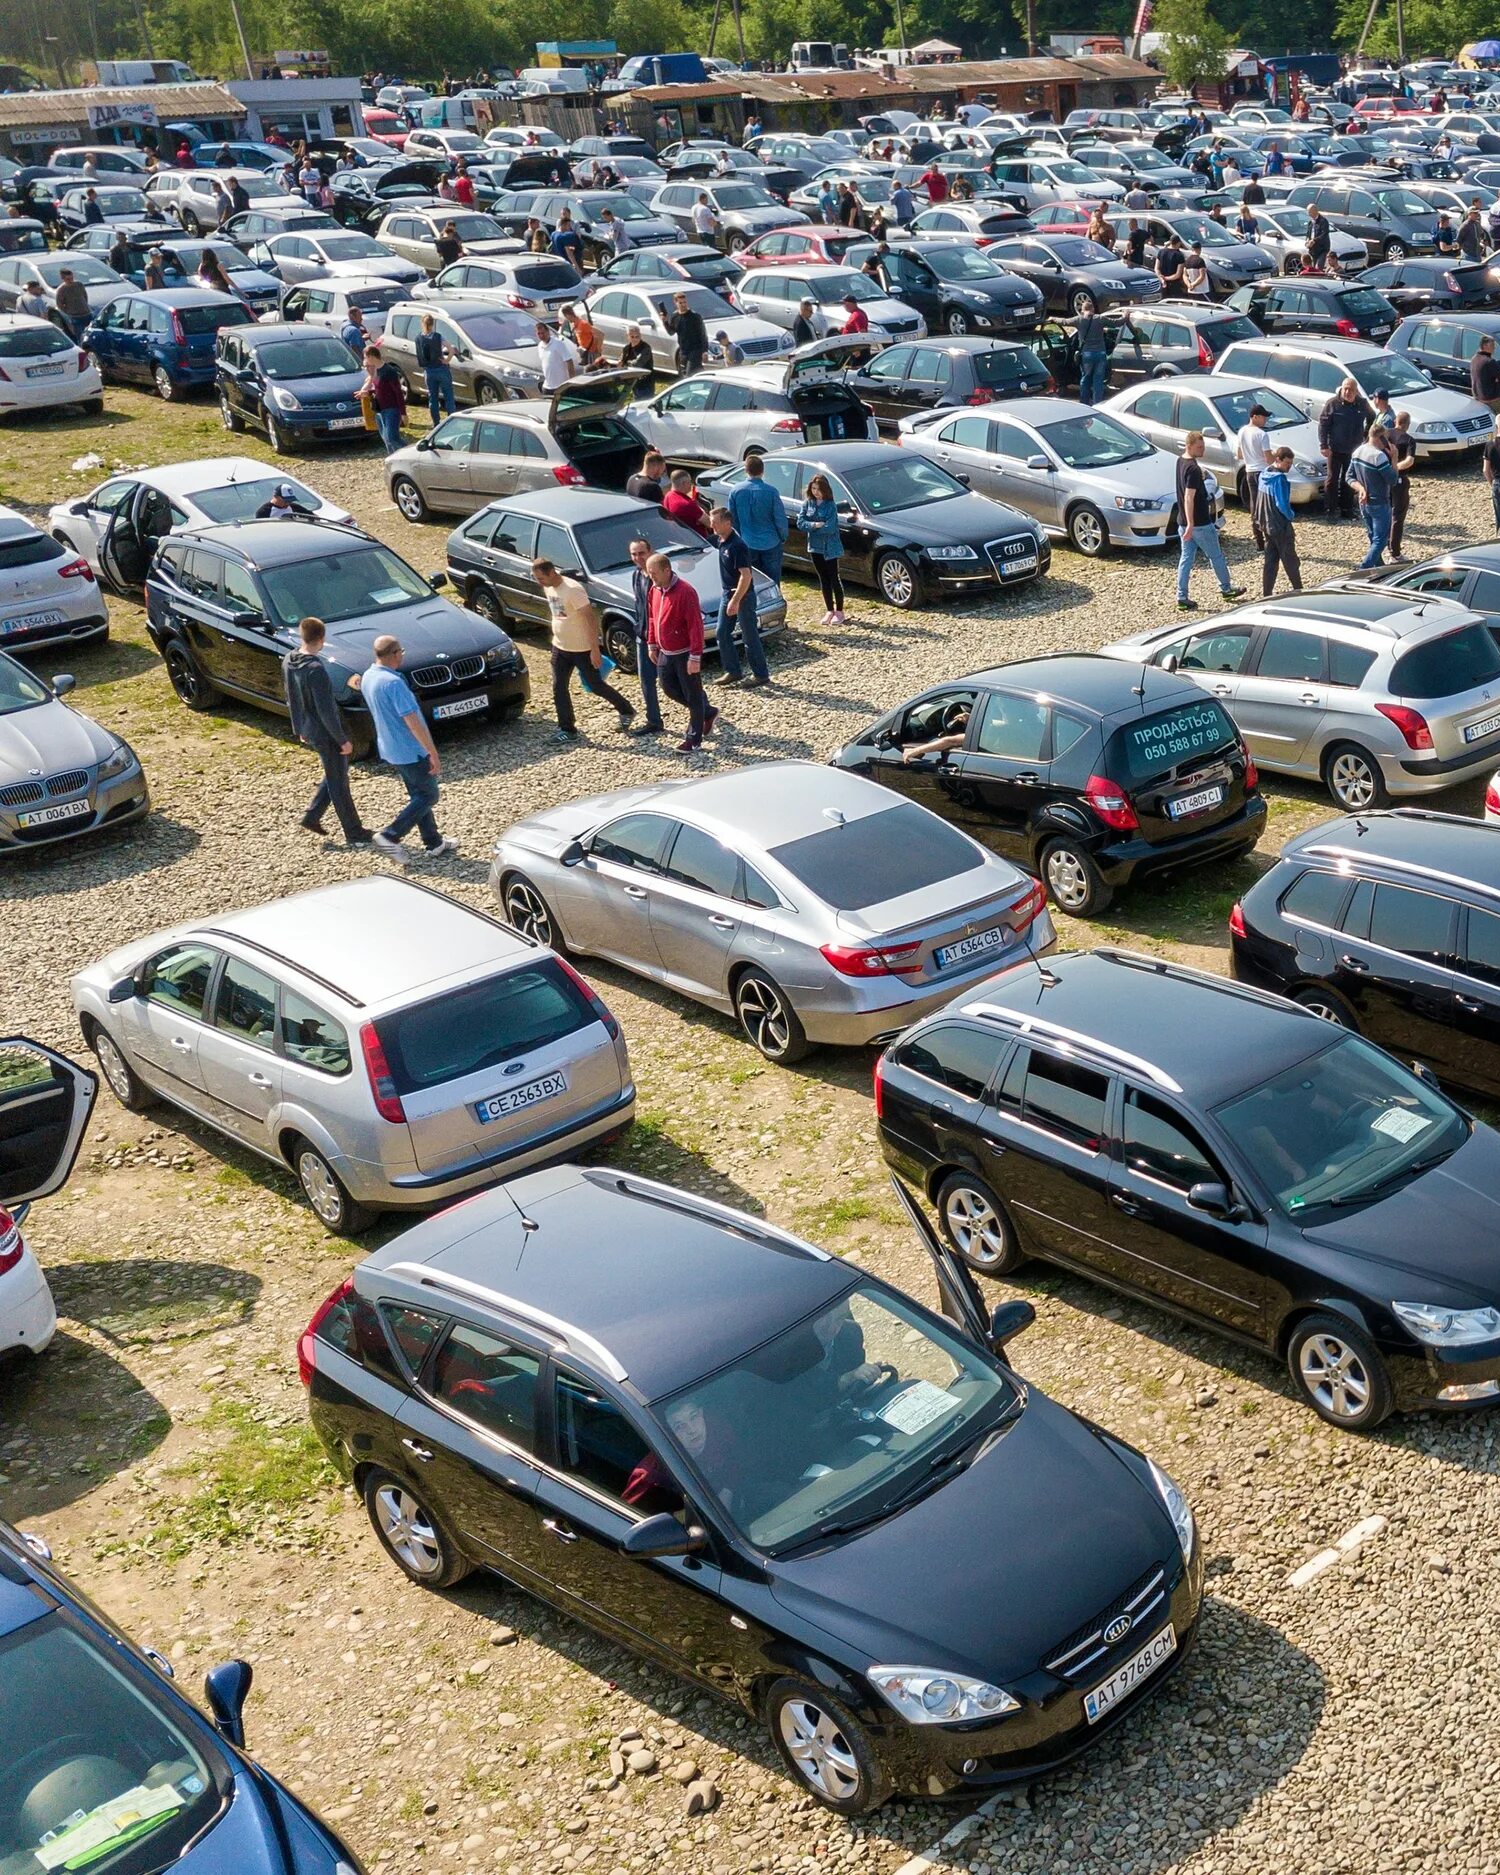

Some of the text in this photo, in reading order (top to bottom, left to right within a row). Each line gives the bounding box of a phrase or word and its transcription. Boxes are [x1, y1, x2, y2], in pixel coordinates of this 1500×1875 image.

[440, 705, 451, 716] AT
[1133, 710, 1217, 745] ПРОДАЄТЬСЯ
[1145, 728, 1220, 760] 050 588 67 99
[28, 802, 87, 824] AT 0061 BX
[1176, 800, 1187, 813] AT
[945, 932, 1000, 961] AT 6364 CB
[489, 1075, 564, 1116] CE 2563 BX
[1098, 1634, 1174, 1708] AT 9768 CM
